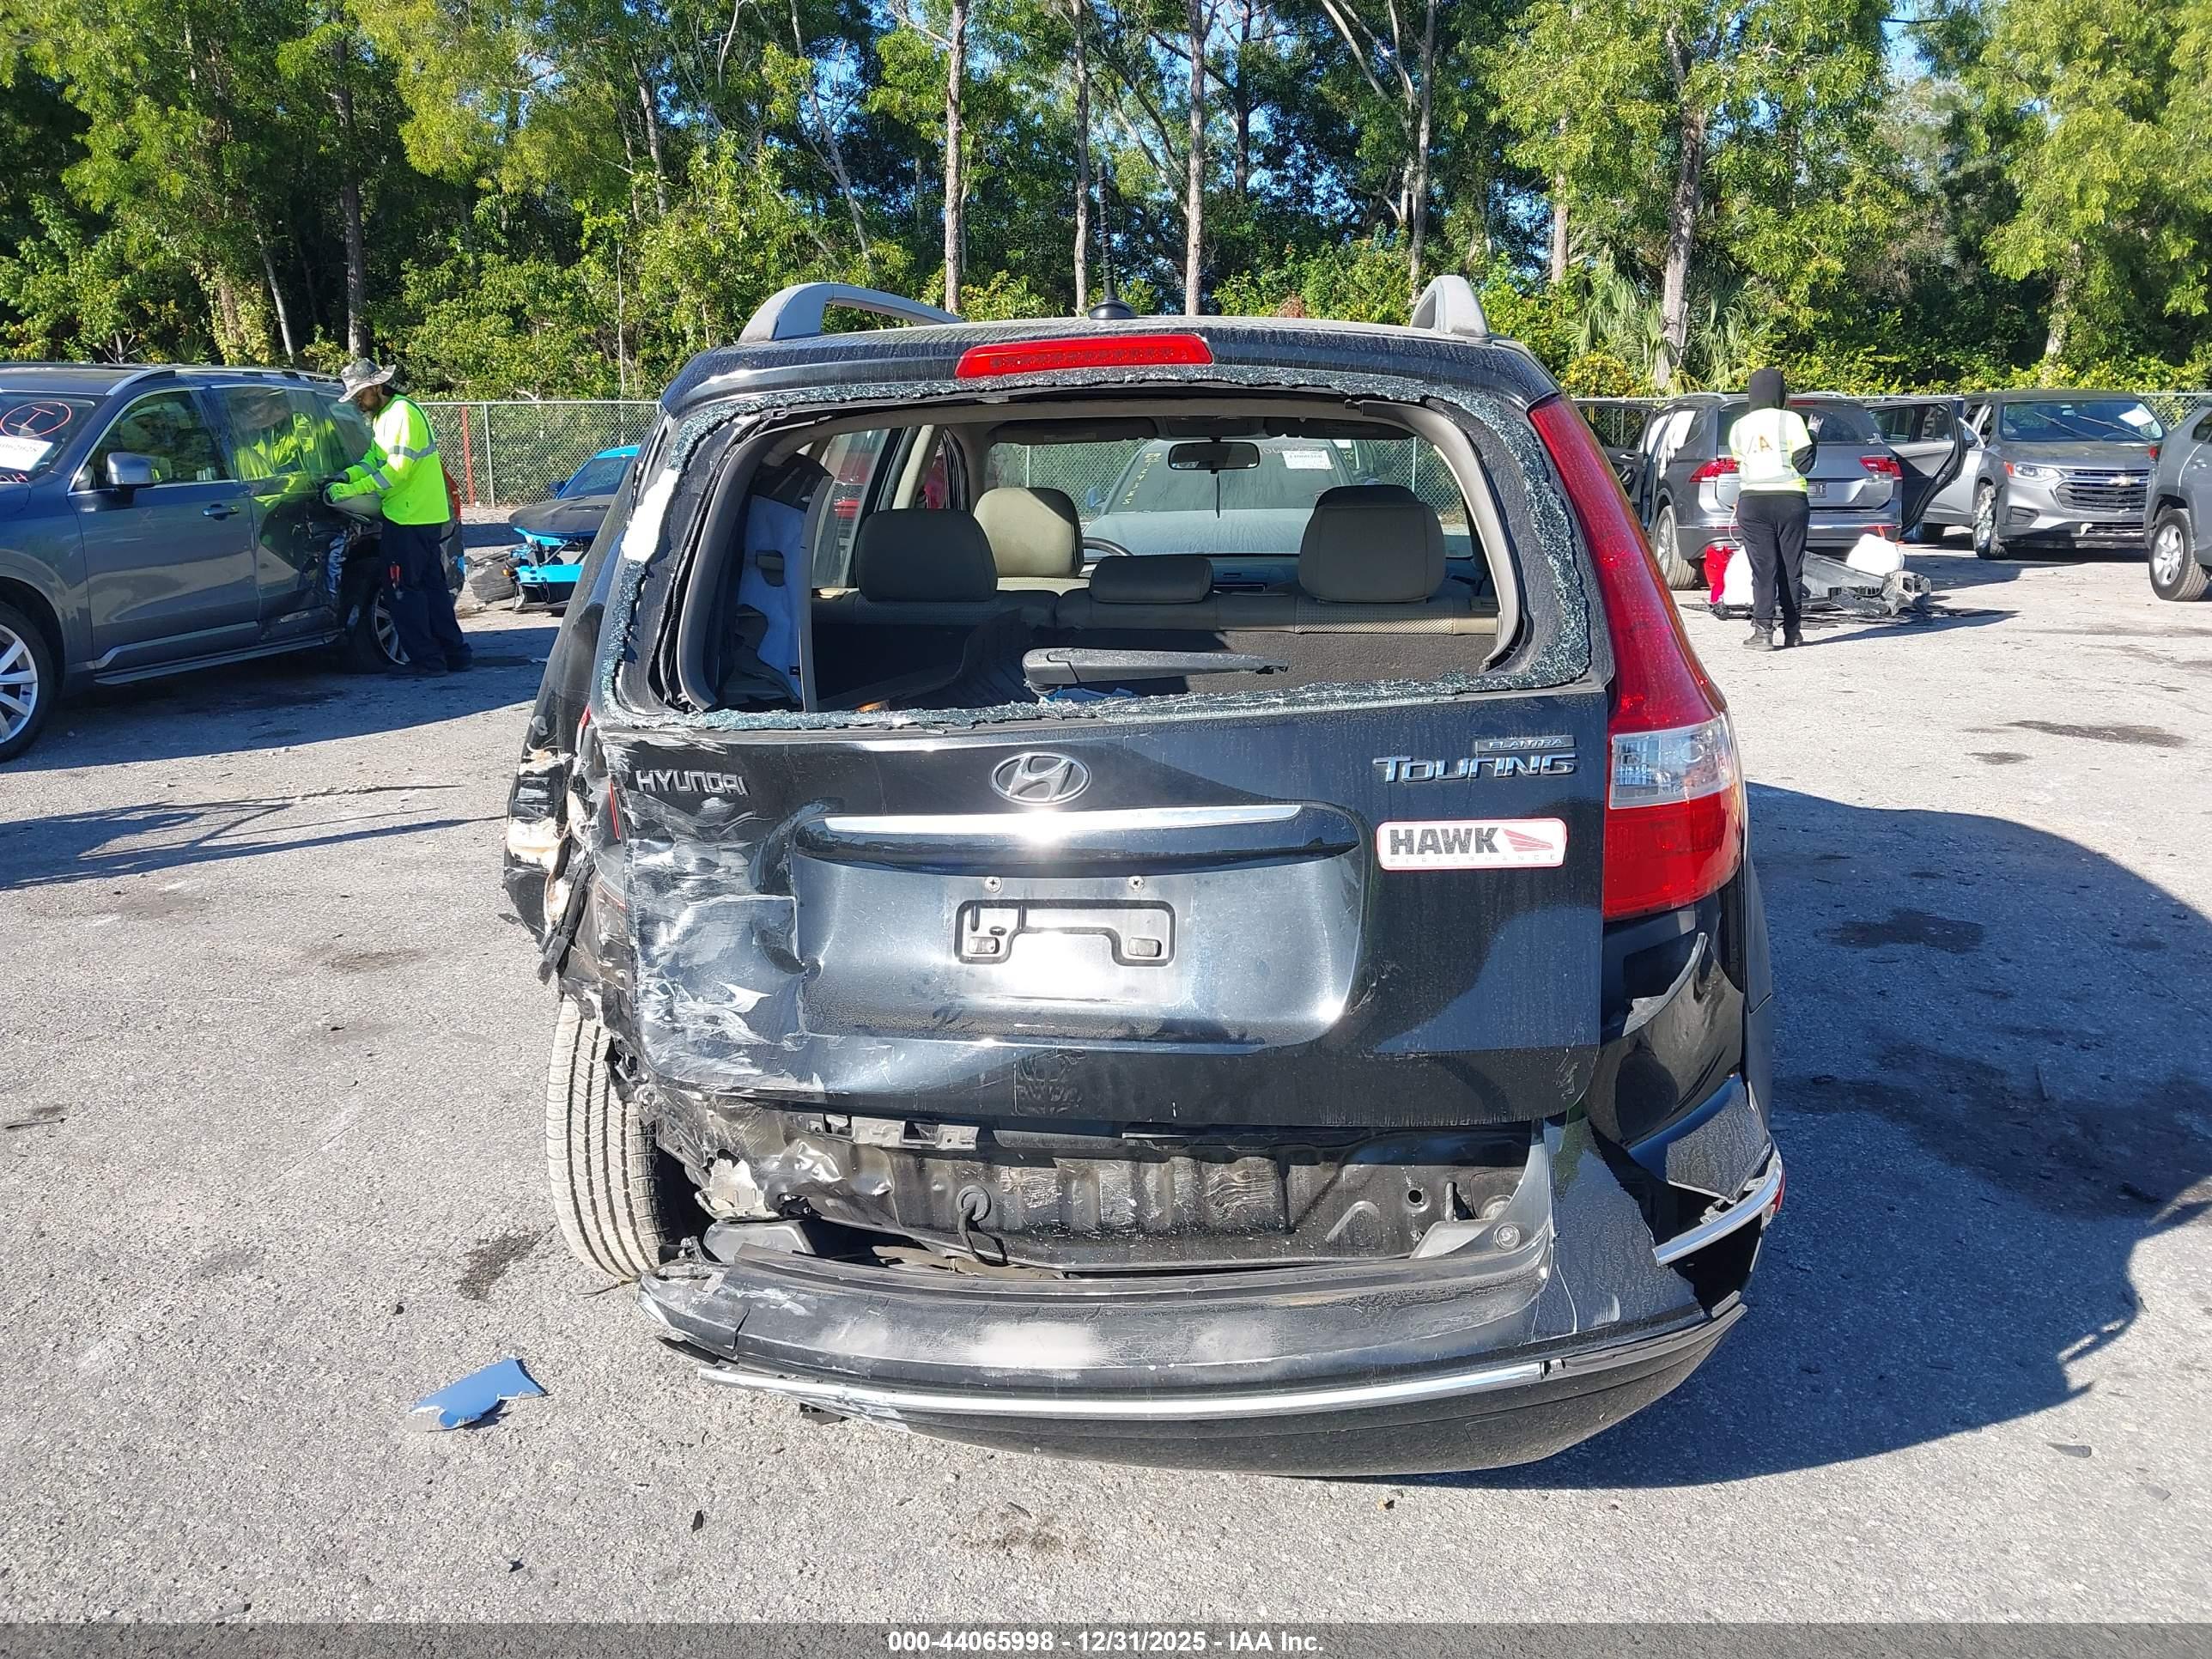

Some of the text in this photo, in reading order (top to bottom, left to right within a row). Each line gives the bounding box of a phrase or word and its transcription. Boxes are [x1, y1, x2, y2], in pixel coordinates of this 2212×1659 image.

[1488, 738, 1565, 750] ELANTRA
[1372, 753, 1577, 782] TOURING
[635, 769, 750, 795] HYUNDAI
[1389, 827, 1501, 856] HAWK
